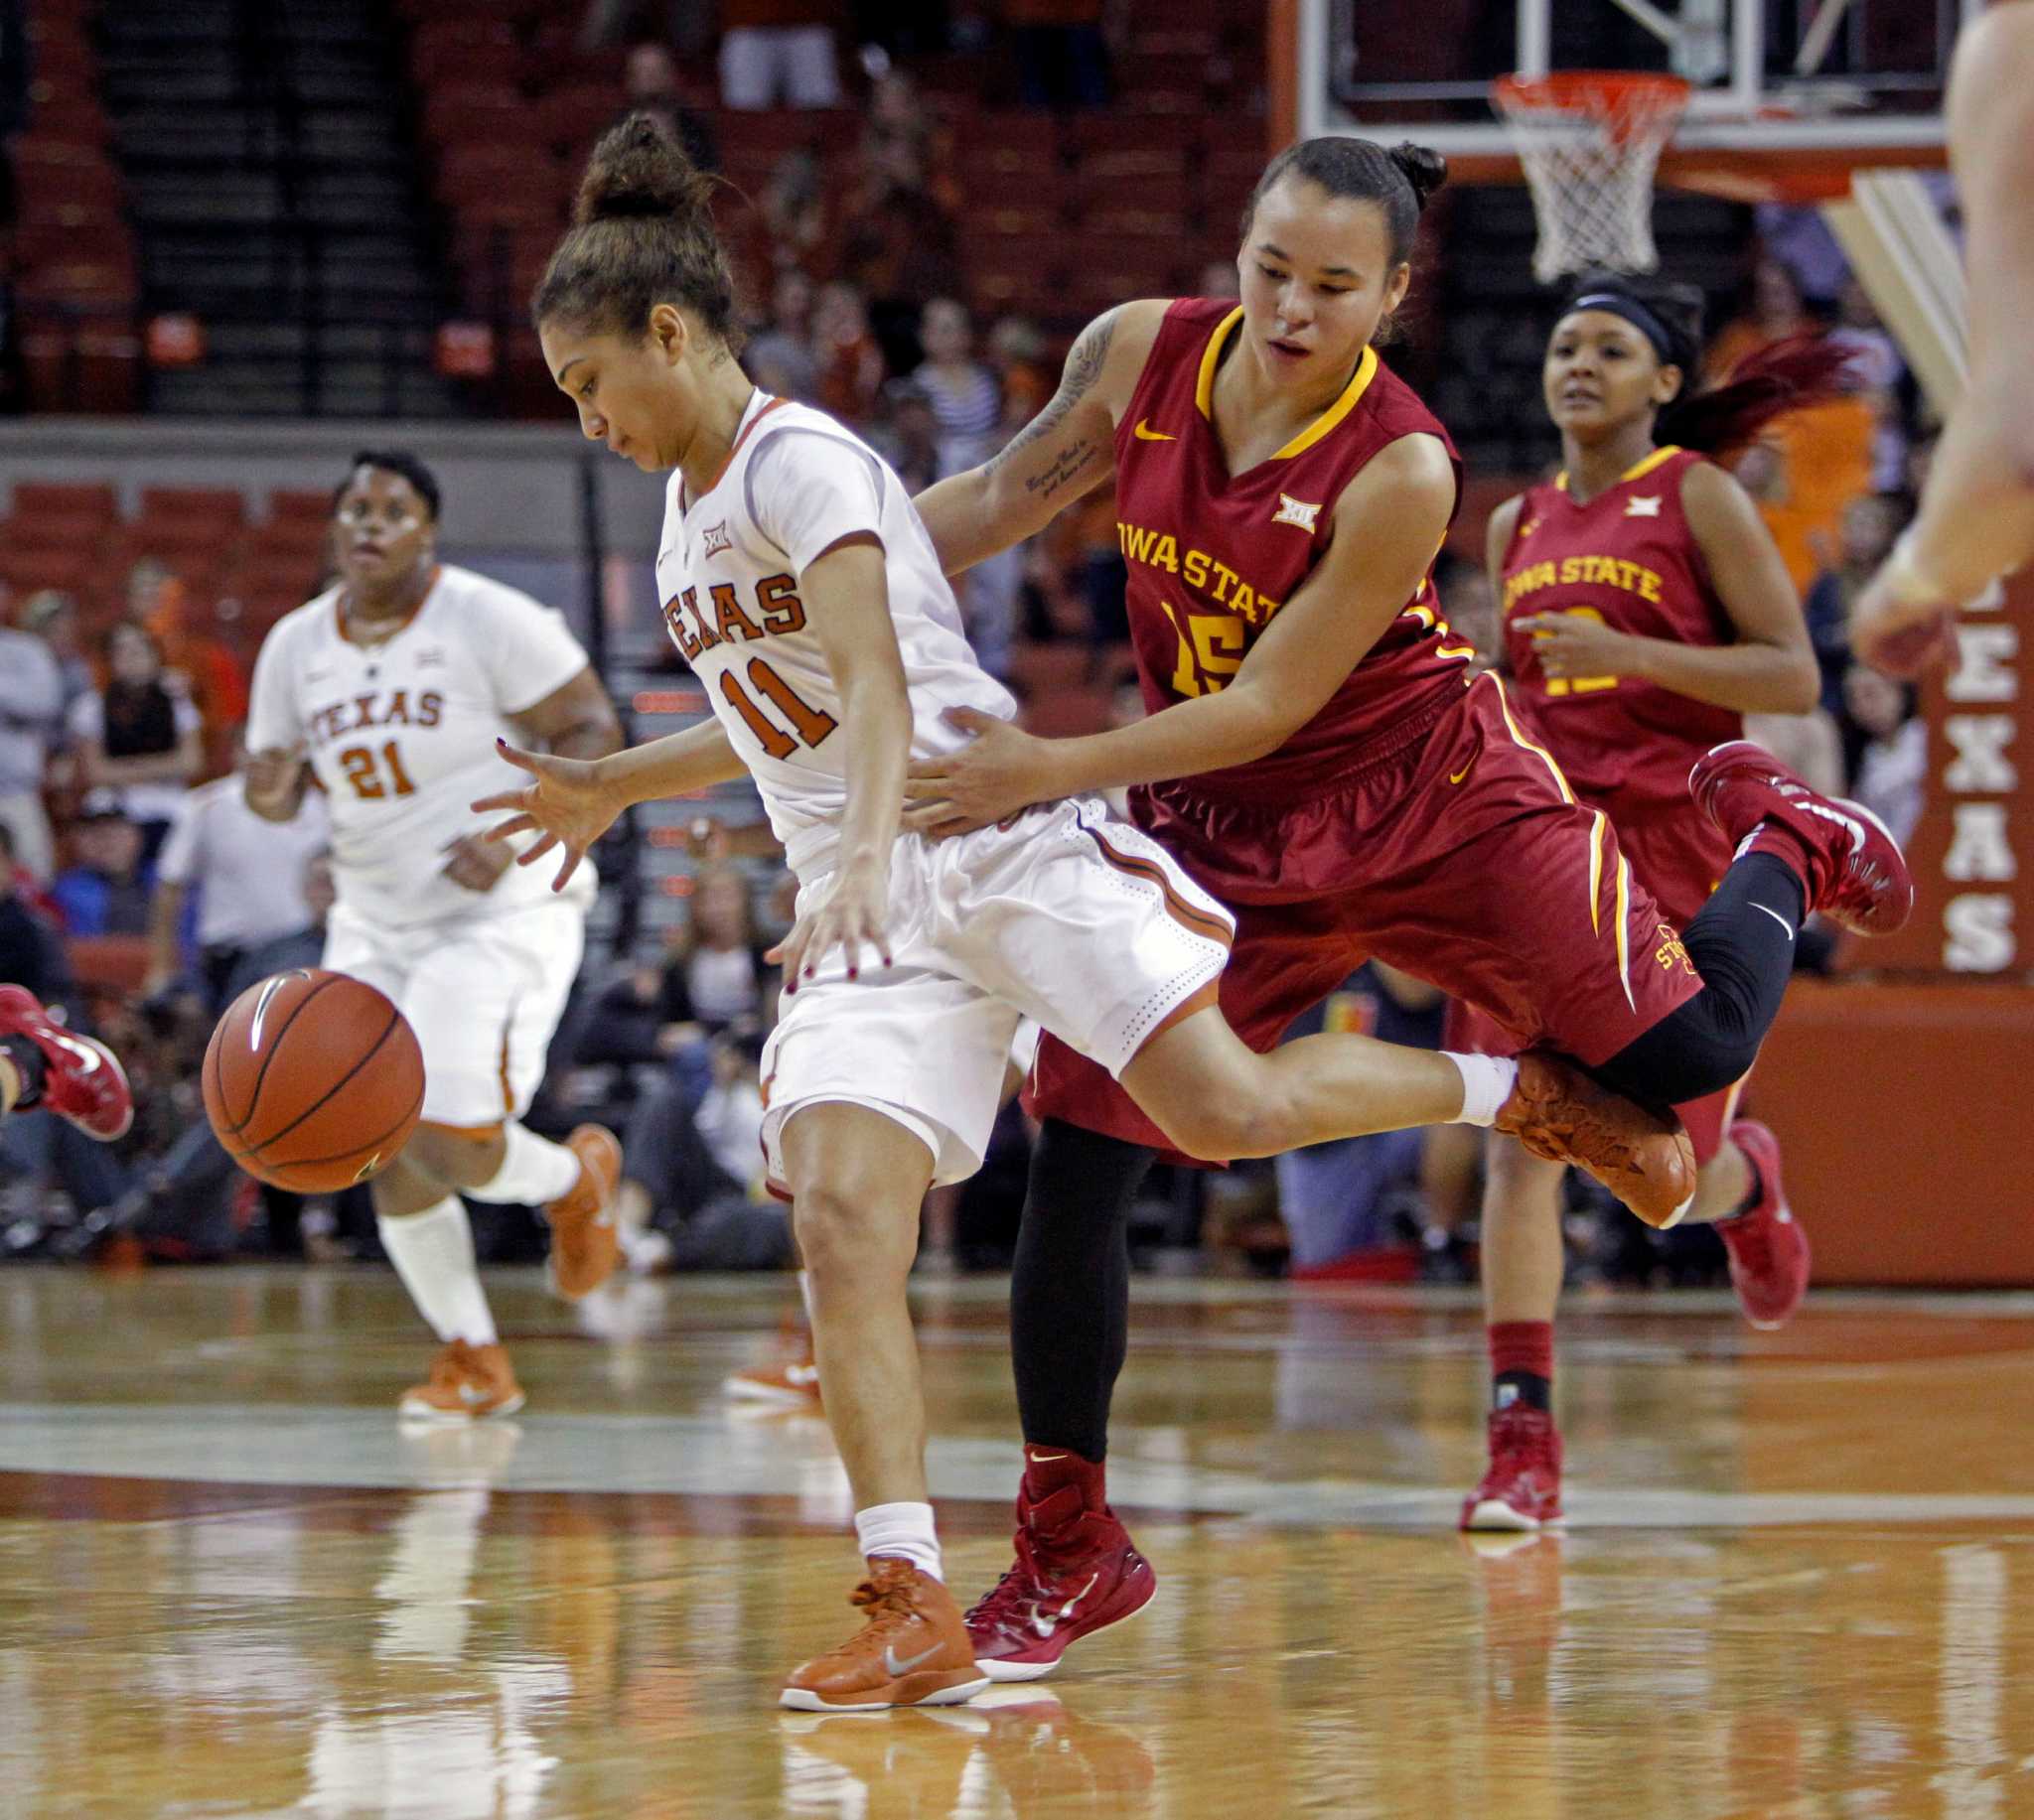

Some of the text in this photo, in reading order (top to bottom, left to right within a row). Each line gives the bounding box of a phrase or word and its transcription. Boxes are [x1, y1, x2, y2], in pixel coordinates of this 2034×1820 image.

[662, 573, 807, 661] EXAS
[1116, 522, 1281, 624] WA STAT
[1559, 555, 1664, 605] STATE
[1160, 601, 1245, 699] 15
[720, 656, 839, 760] 11
[340, 742, 415, 799] 21
[1943, 574, 2021, 974] EXAS
